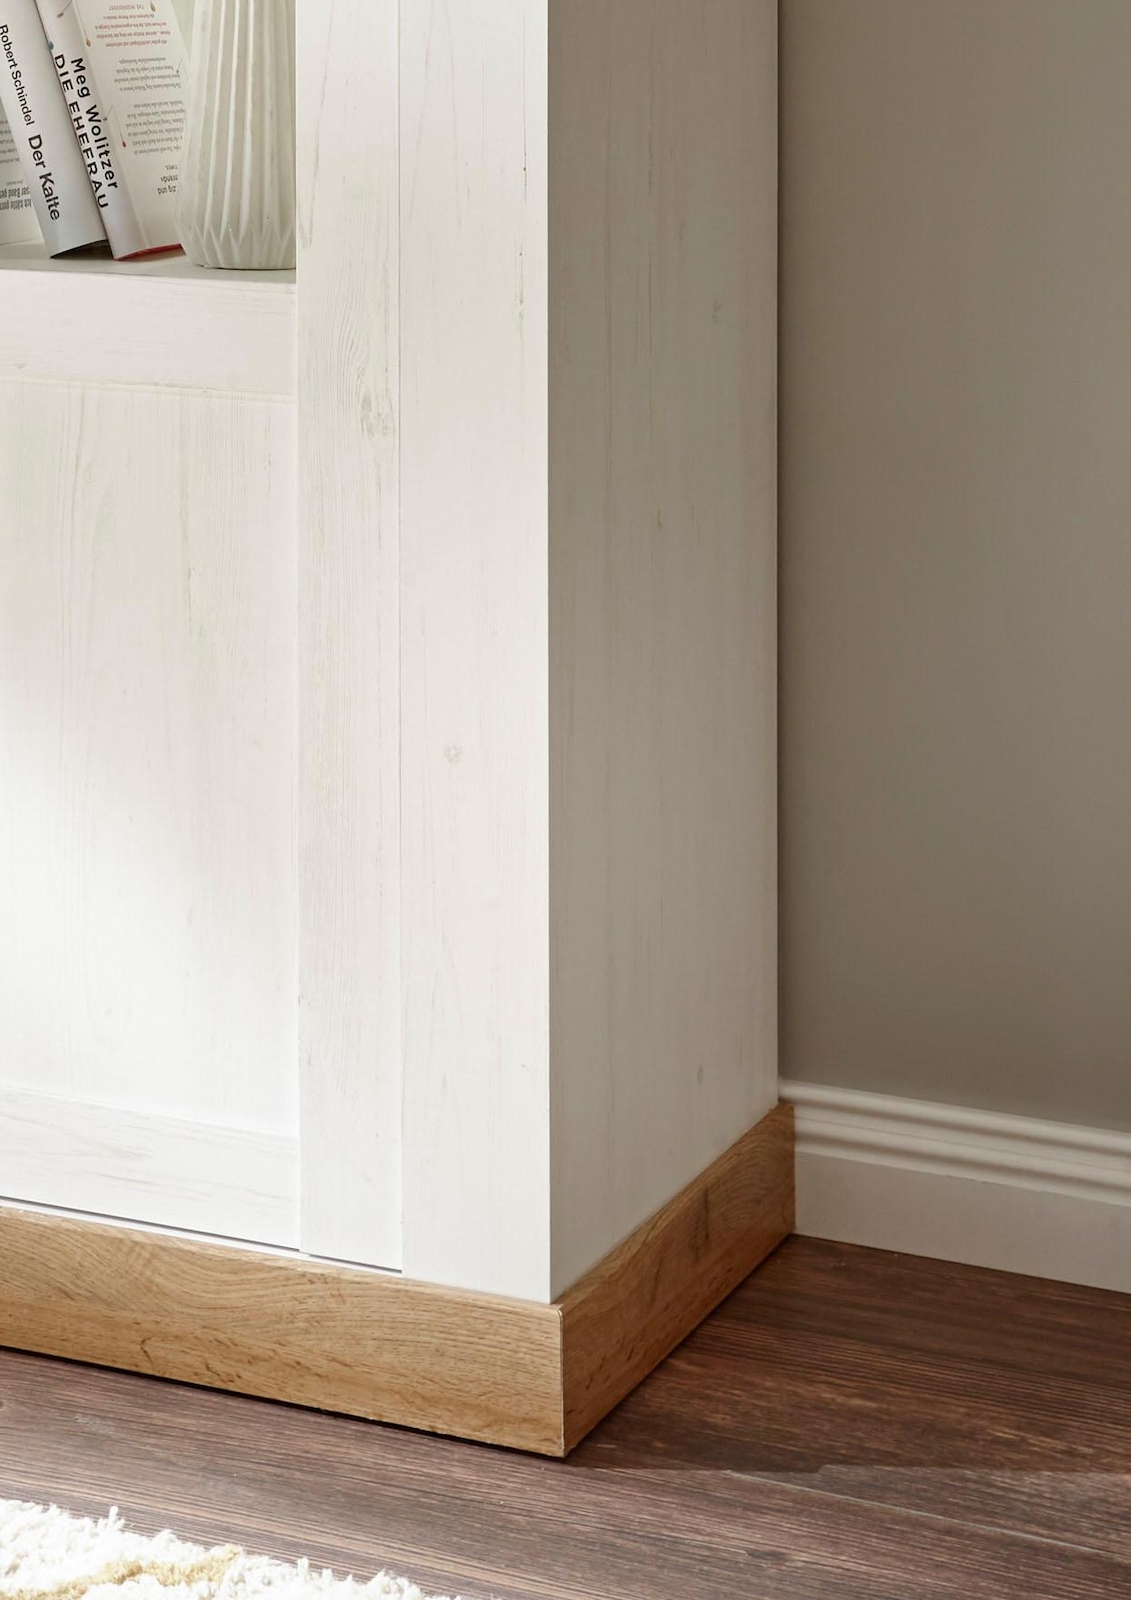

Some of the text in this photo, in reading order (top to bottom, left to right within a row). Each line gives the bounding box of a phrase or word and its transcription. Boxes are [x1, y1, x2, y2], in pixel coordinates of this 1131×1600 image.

[11, 69, 36, 126] Schindel
[28, 134, 47, 169] Der
[39, 172, 60, 221] Kalte
[54, 54, 109, 209] DIE EHEFRAU
[71, 57, 119, 189] Meg Wolitzer
